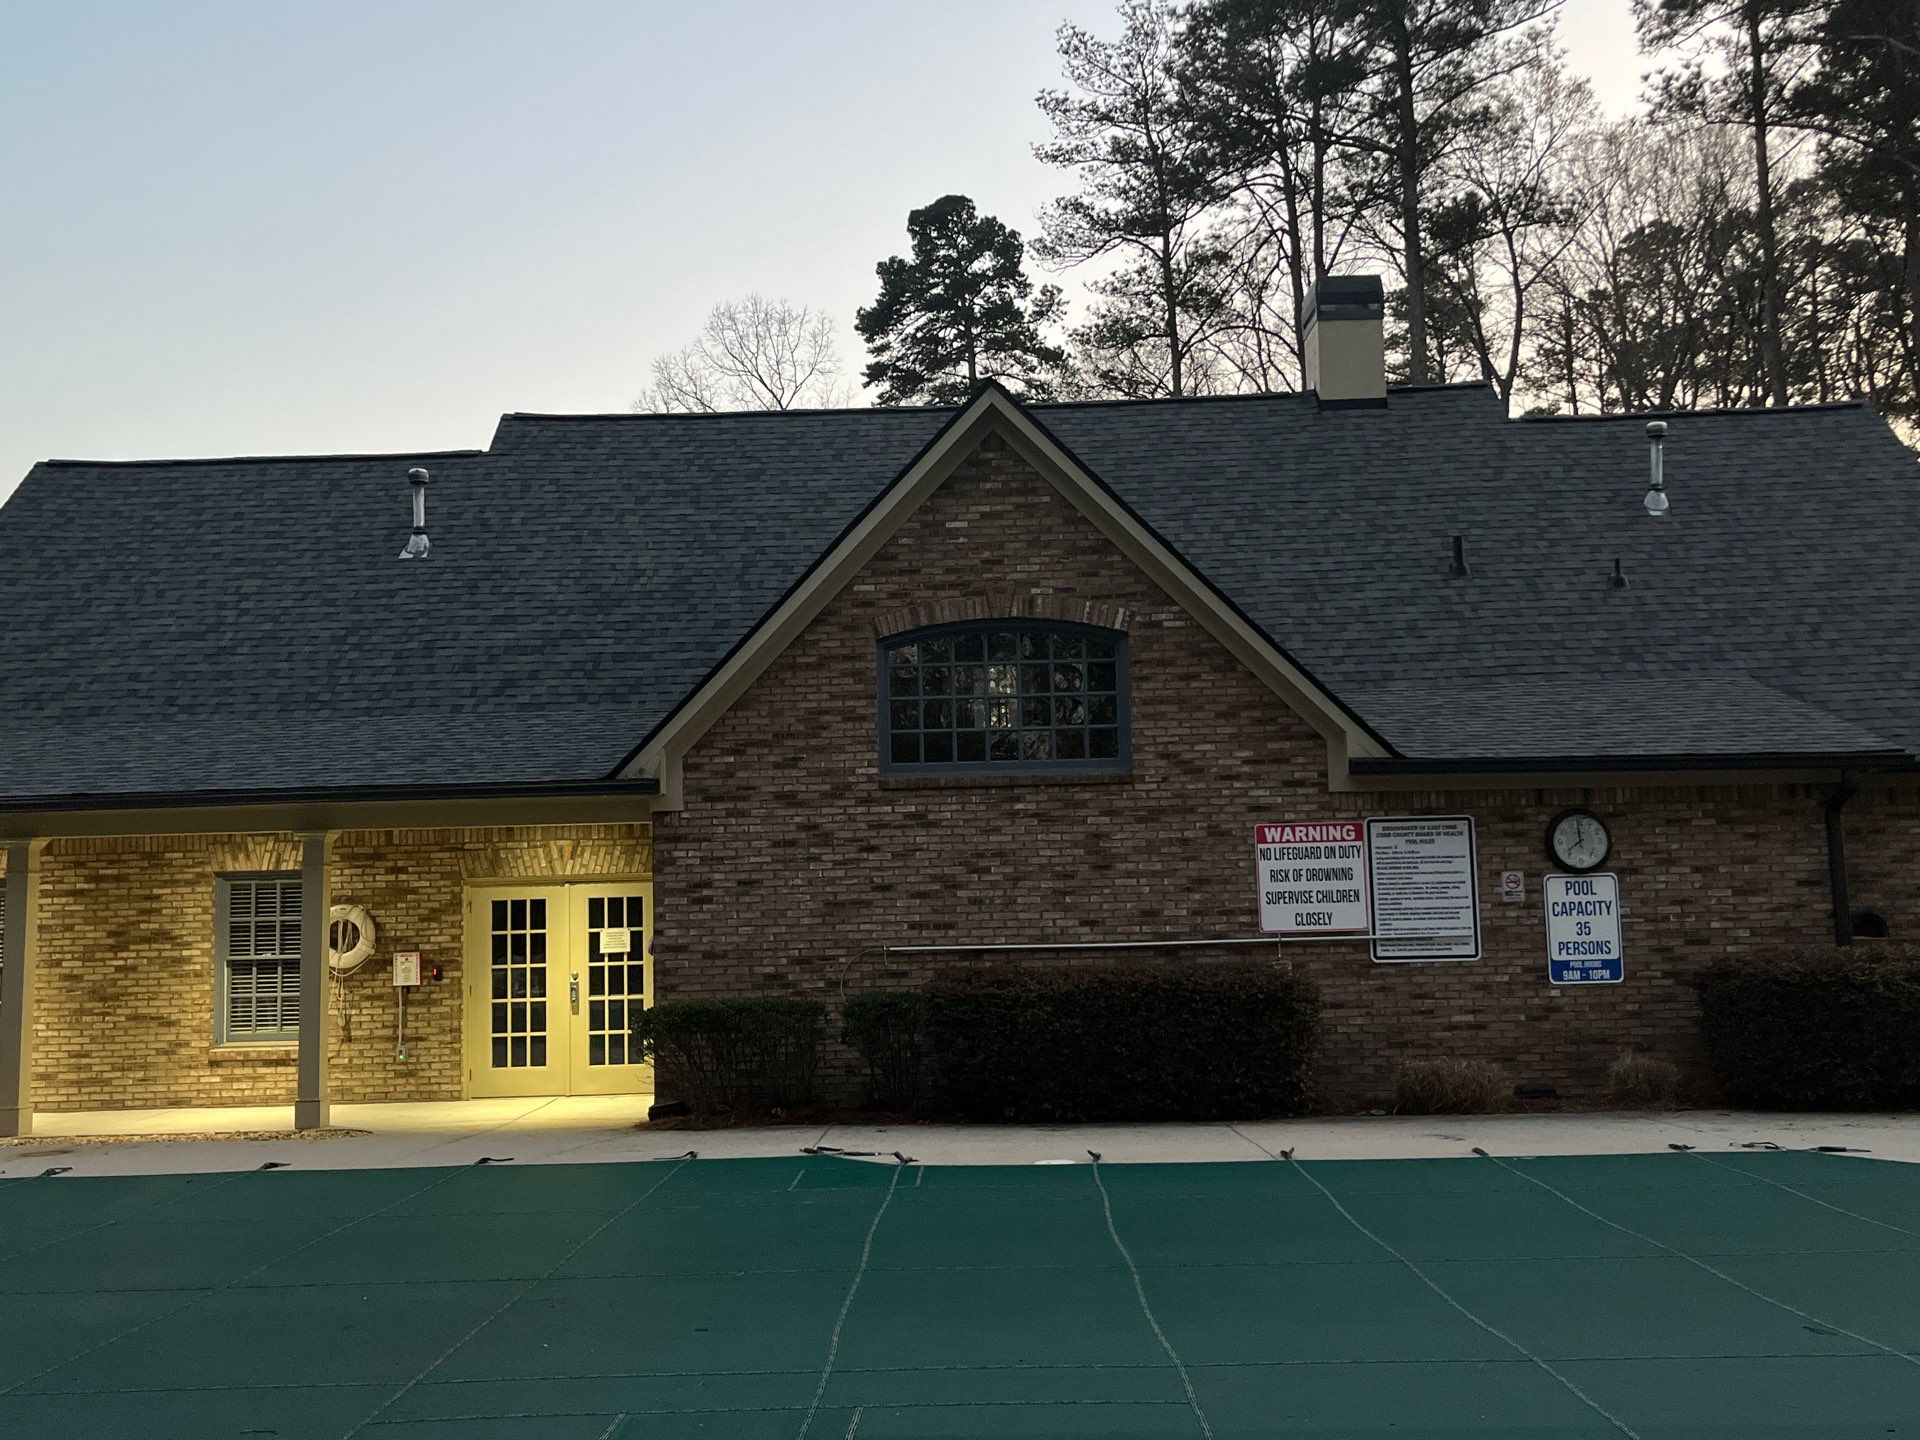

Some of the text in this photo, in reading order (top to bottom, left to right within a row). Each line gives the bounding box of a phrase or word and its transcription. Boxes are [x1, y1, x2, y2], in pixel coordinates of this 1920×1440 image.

[1264, 825, 1356, 842] WARNING
[1259, 845, 1361, 861] NO LIFEGUARD ON DUTY
[1270, 867, 1354, 883] RISK OF DROWNING
[1565, 880, 1597, 896] POOL
[1265, 889, 1360, 905] SUPERVISE CHILDREN
[1552, 901, 1612, 917] CAPACITY
[1295, 912, 1333, 926] CLOSELY
[1576, 921, 1591, 936] 35
[1558, 941, 1612, 956] PERSONS
[1562, 970, 1581, 980] 9AM
[1589, 969, 1610, 980] 10PM
